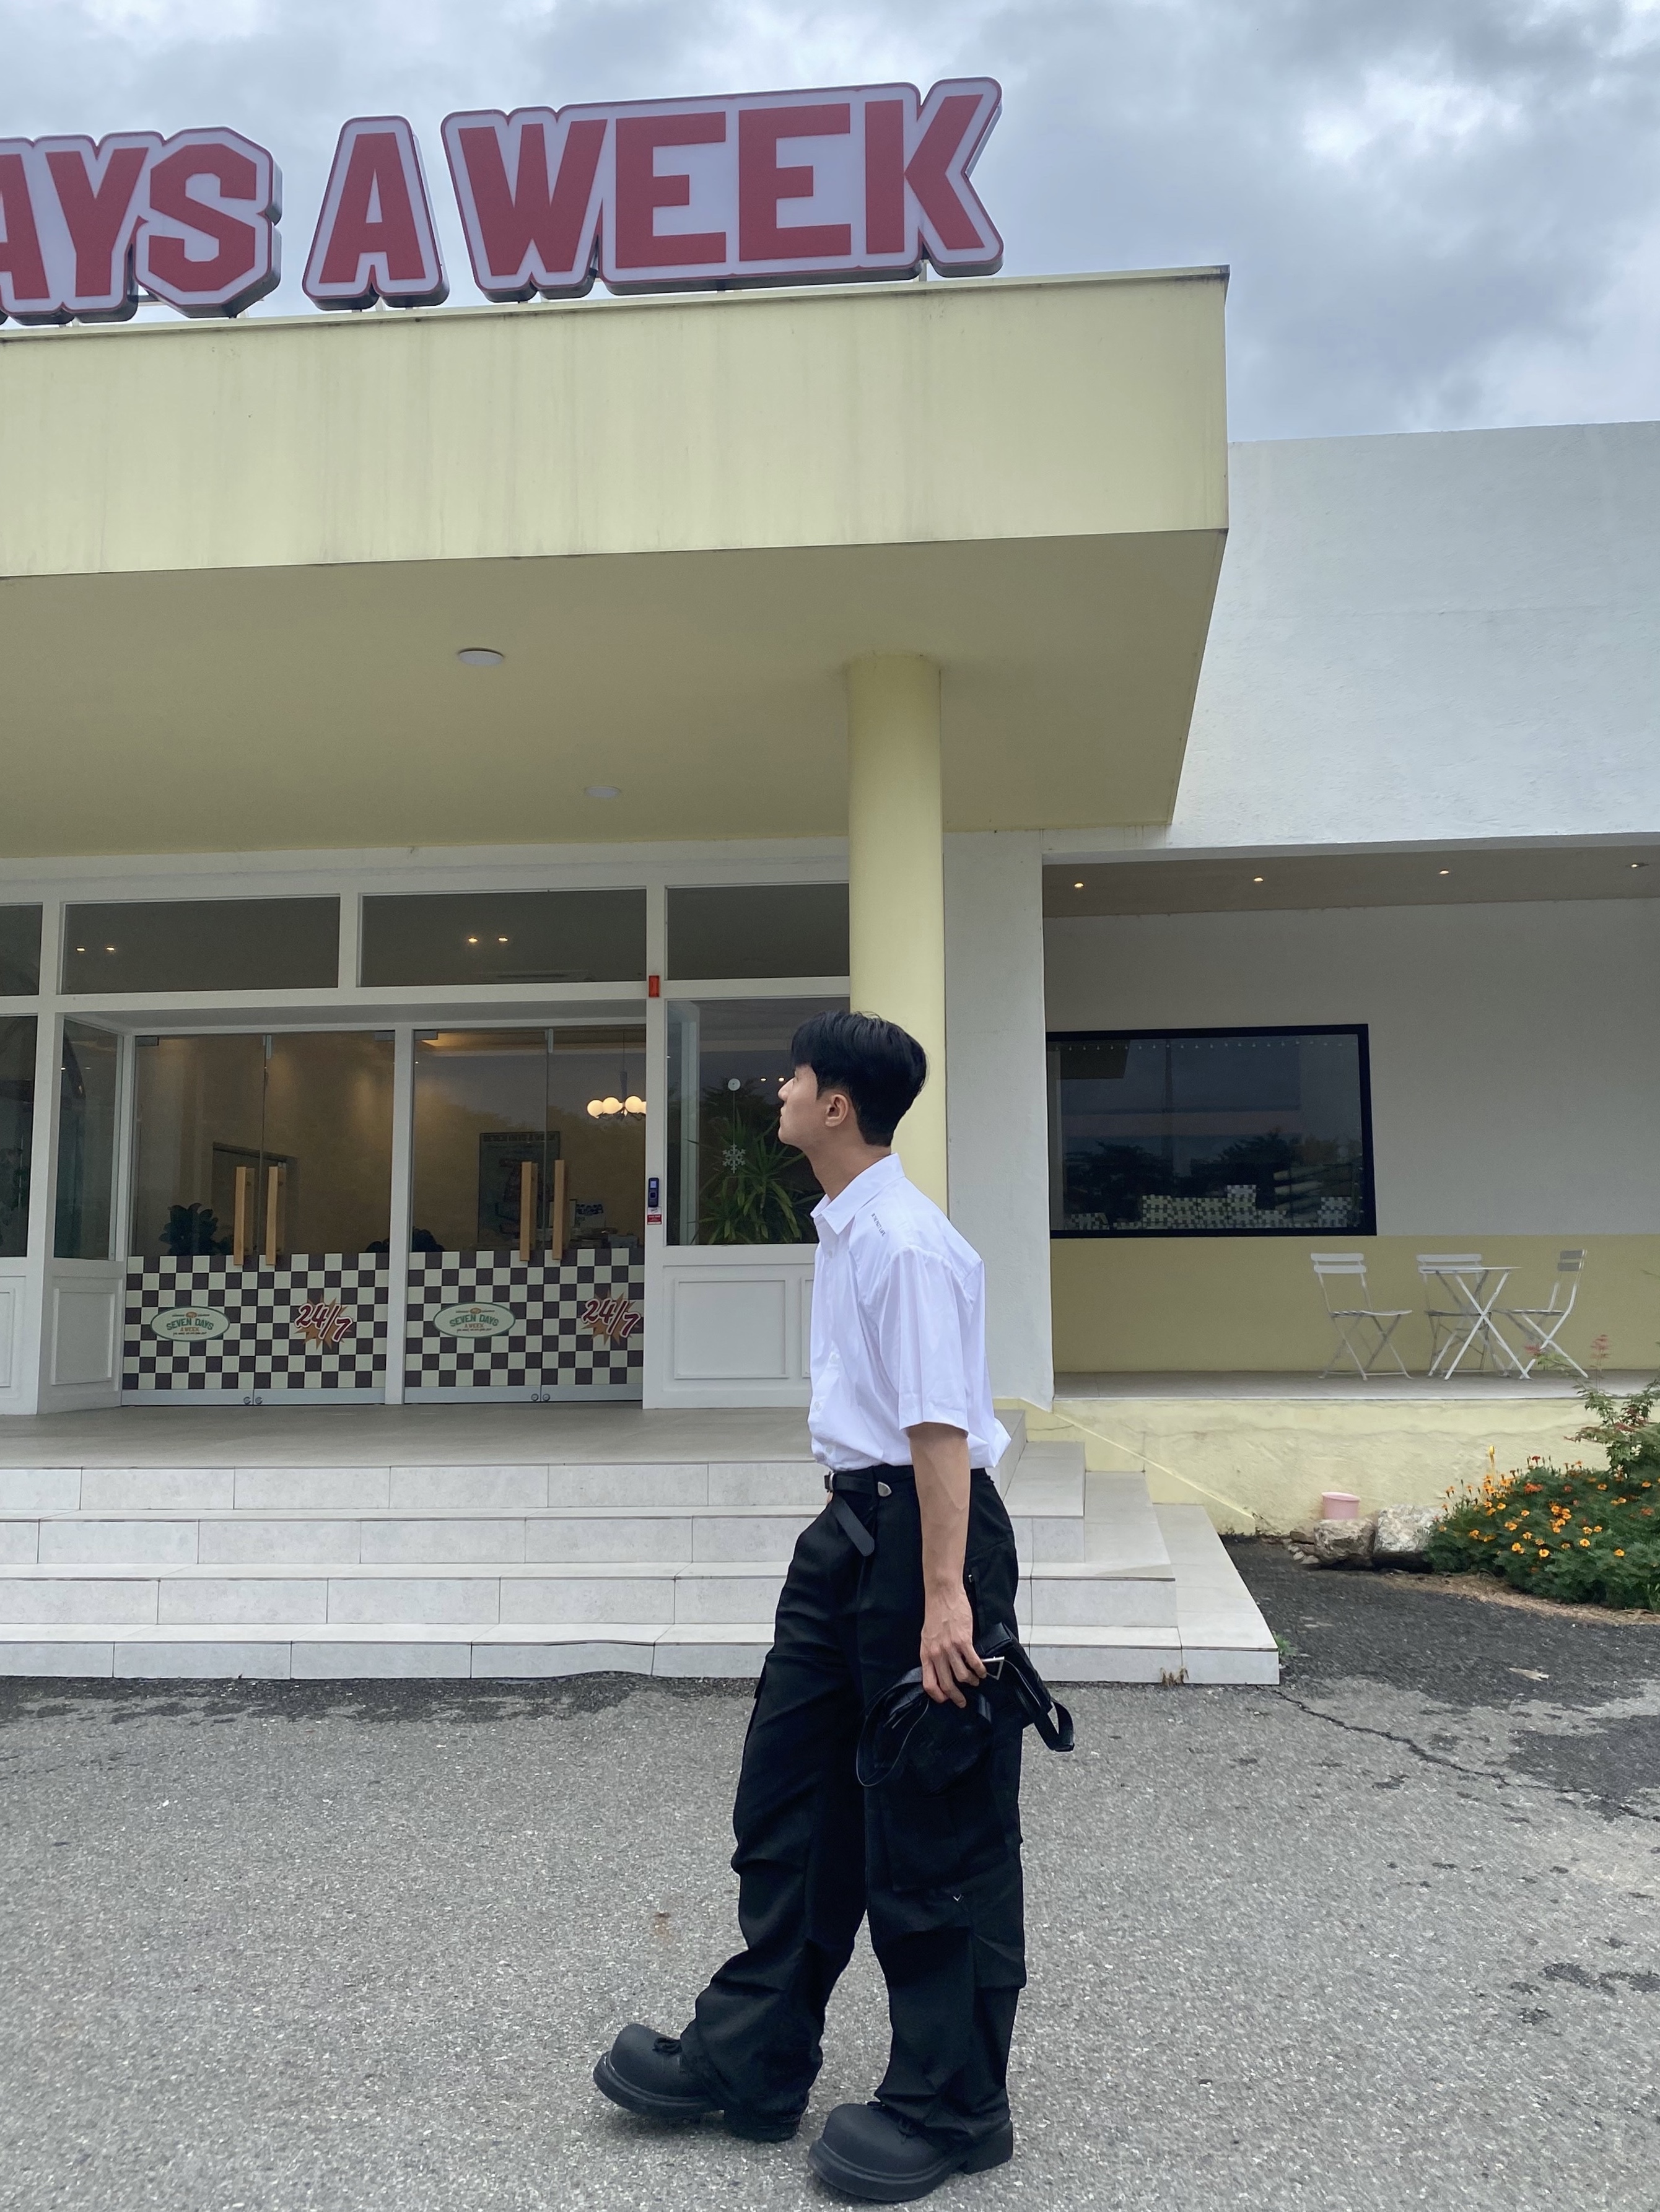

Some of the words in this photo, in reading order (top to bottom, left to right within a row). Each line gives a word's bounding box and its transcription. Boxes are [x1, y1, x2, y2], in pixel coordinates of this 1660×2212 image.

[313, 126, 432, 290] A
[453, 90, 991, 282] WEEK
[166, 1318, 191, 1331] SEVEN
[195, 1318, 214, 1330] DAYS
[294, 1303, 352, 1342] 24/7
[449, 1314, 476, 1326] SEVEN
[479, 1314, 499, 1326] DAYS
[581, 1298, 640, 1338] 24/7
